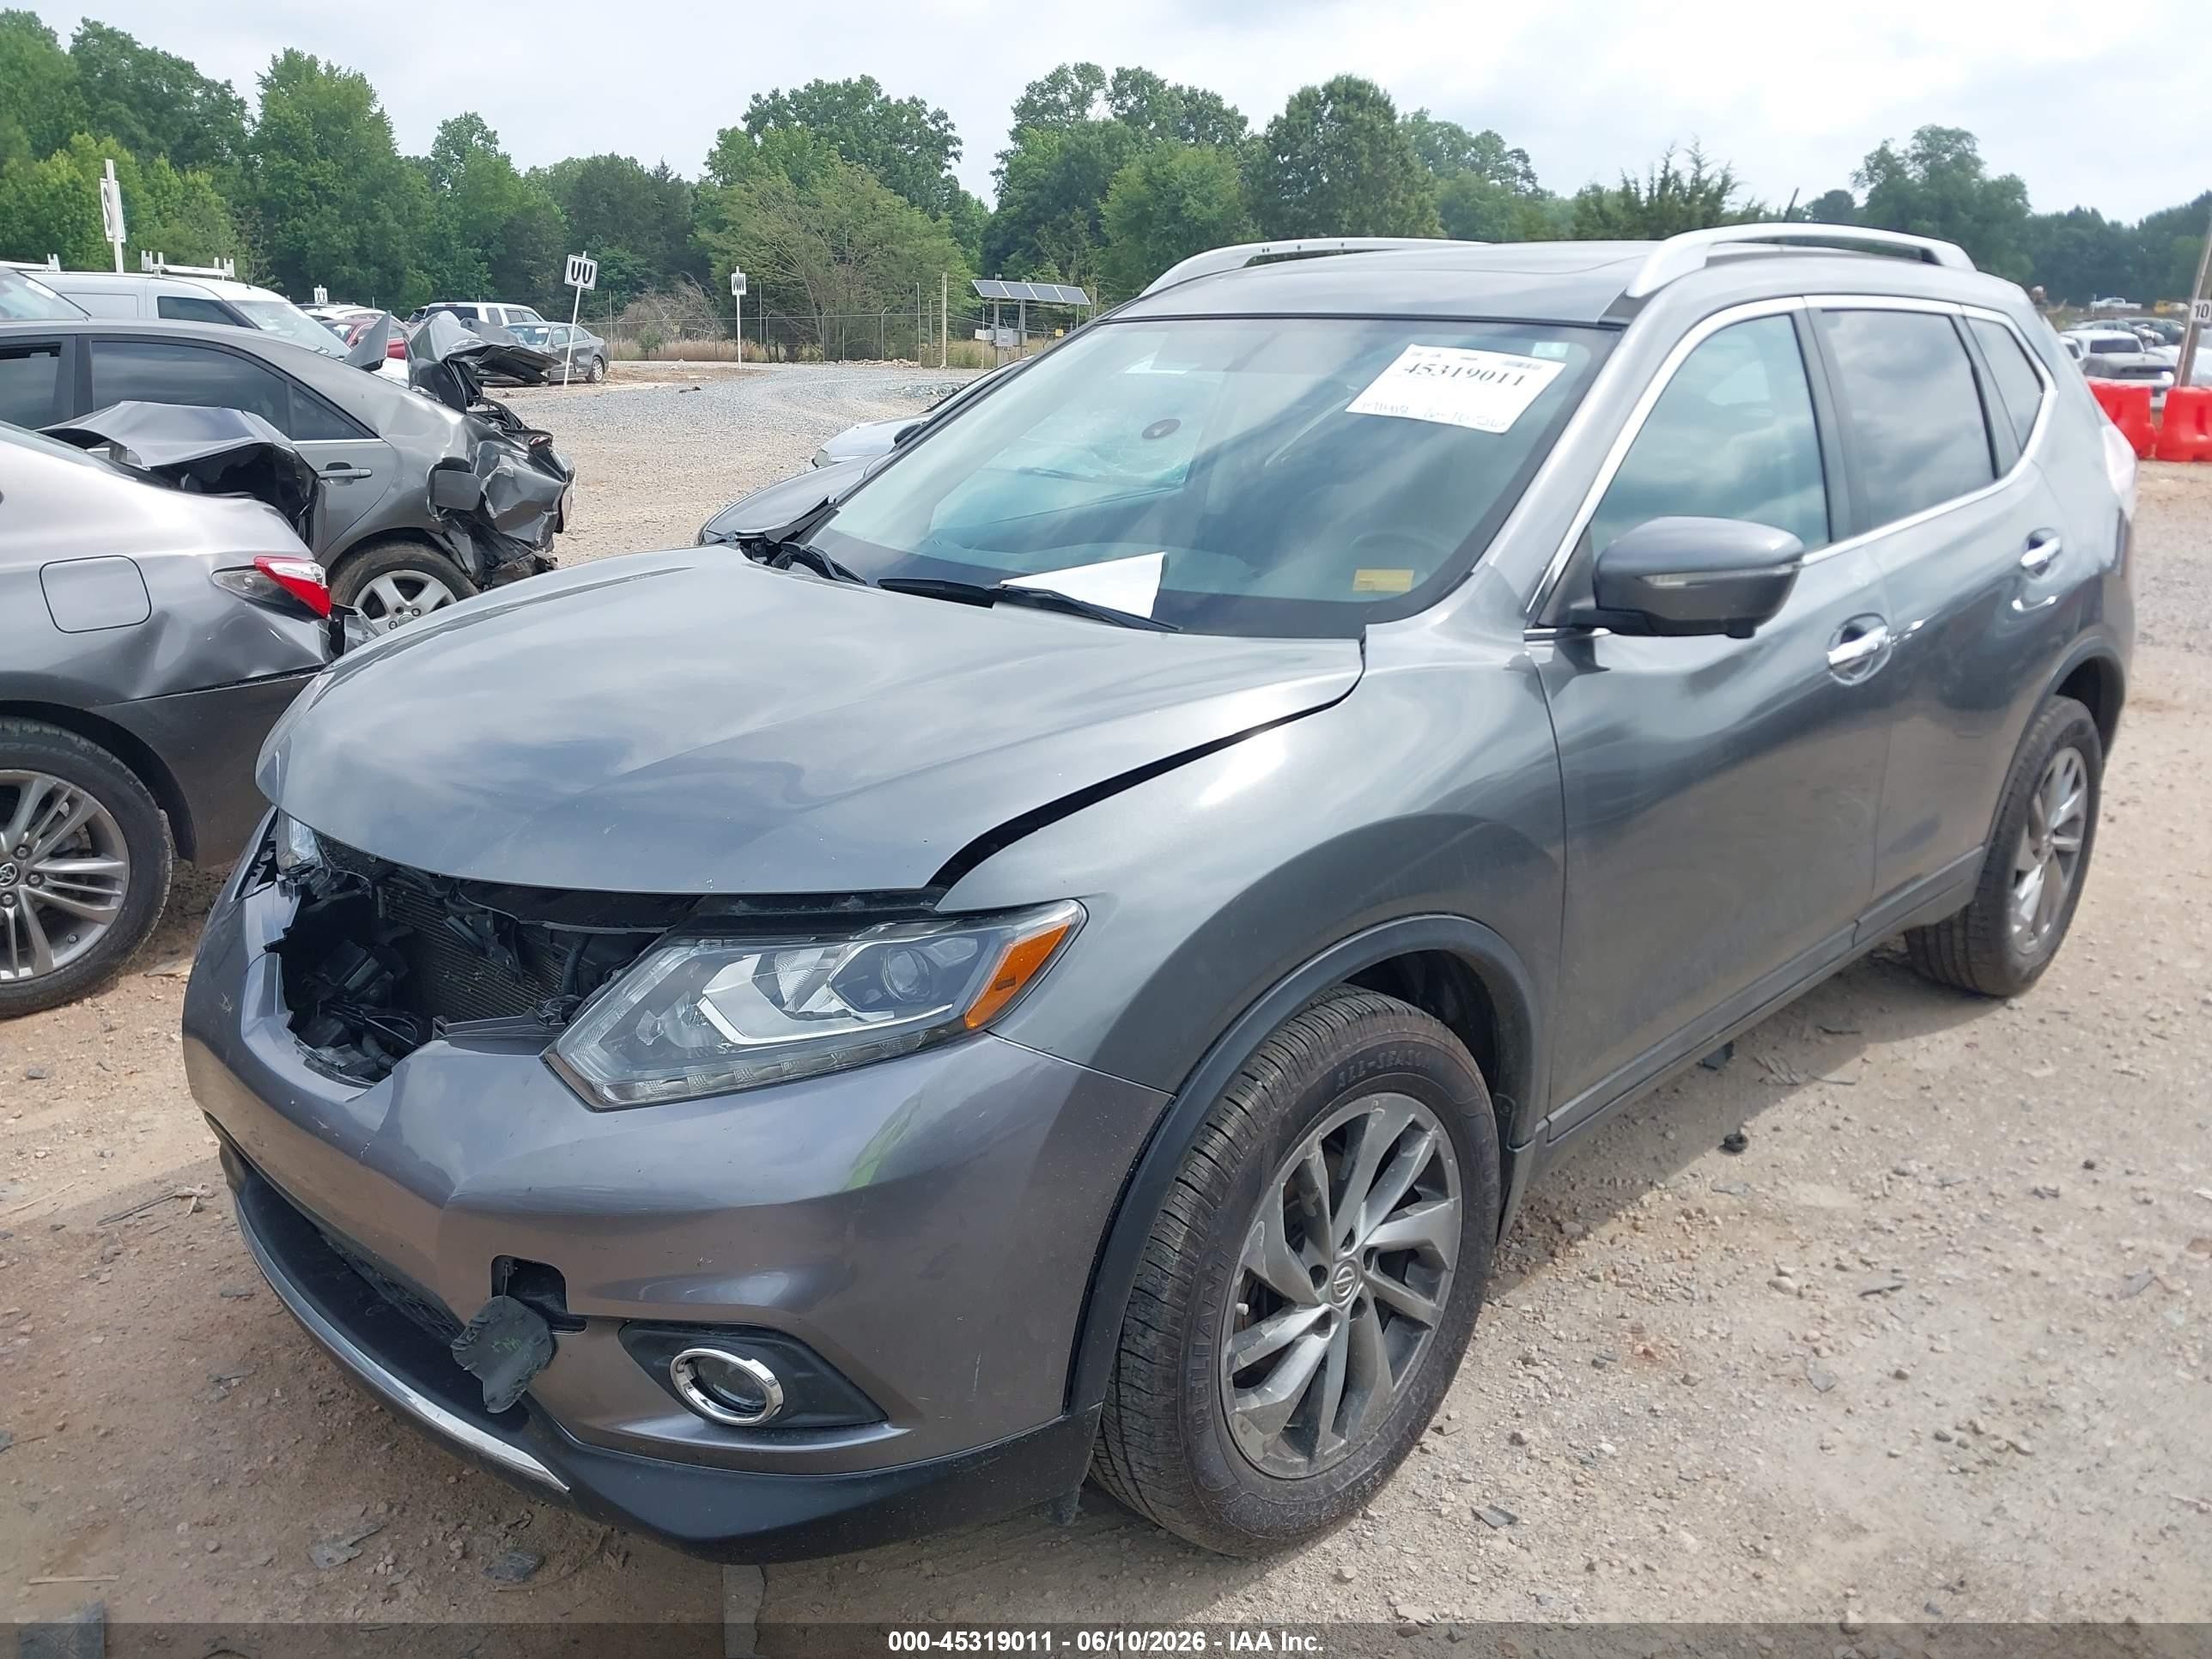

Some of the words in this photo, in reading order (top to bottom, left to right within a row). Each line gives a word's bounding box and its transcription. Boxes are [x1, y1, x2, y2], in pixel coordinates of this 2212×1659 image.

[571, 260, 593, 284] UU
[2195, 303, 2210, 318] 10
[1404, 362, 1526, 386] 45319011
